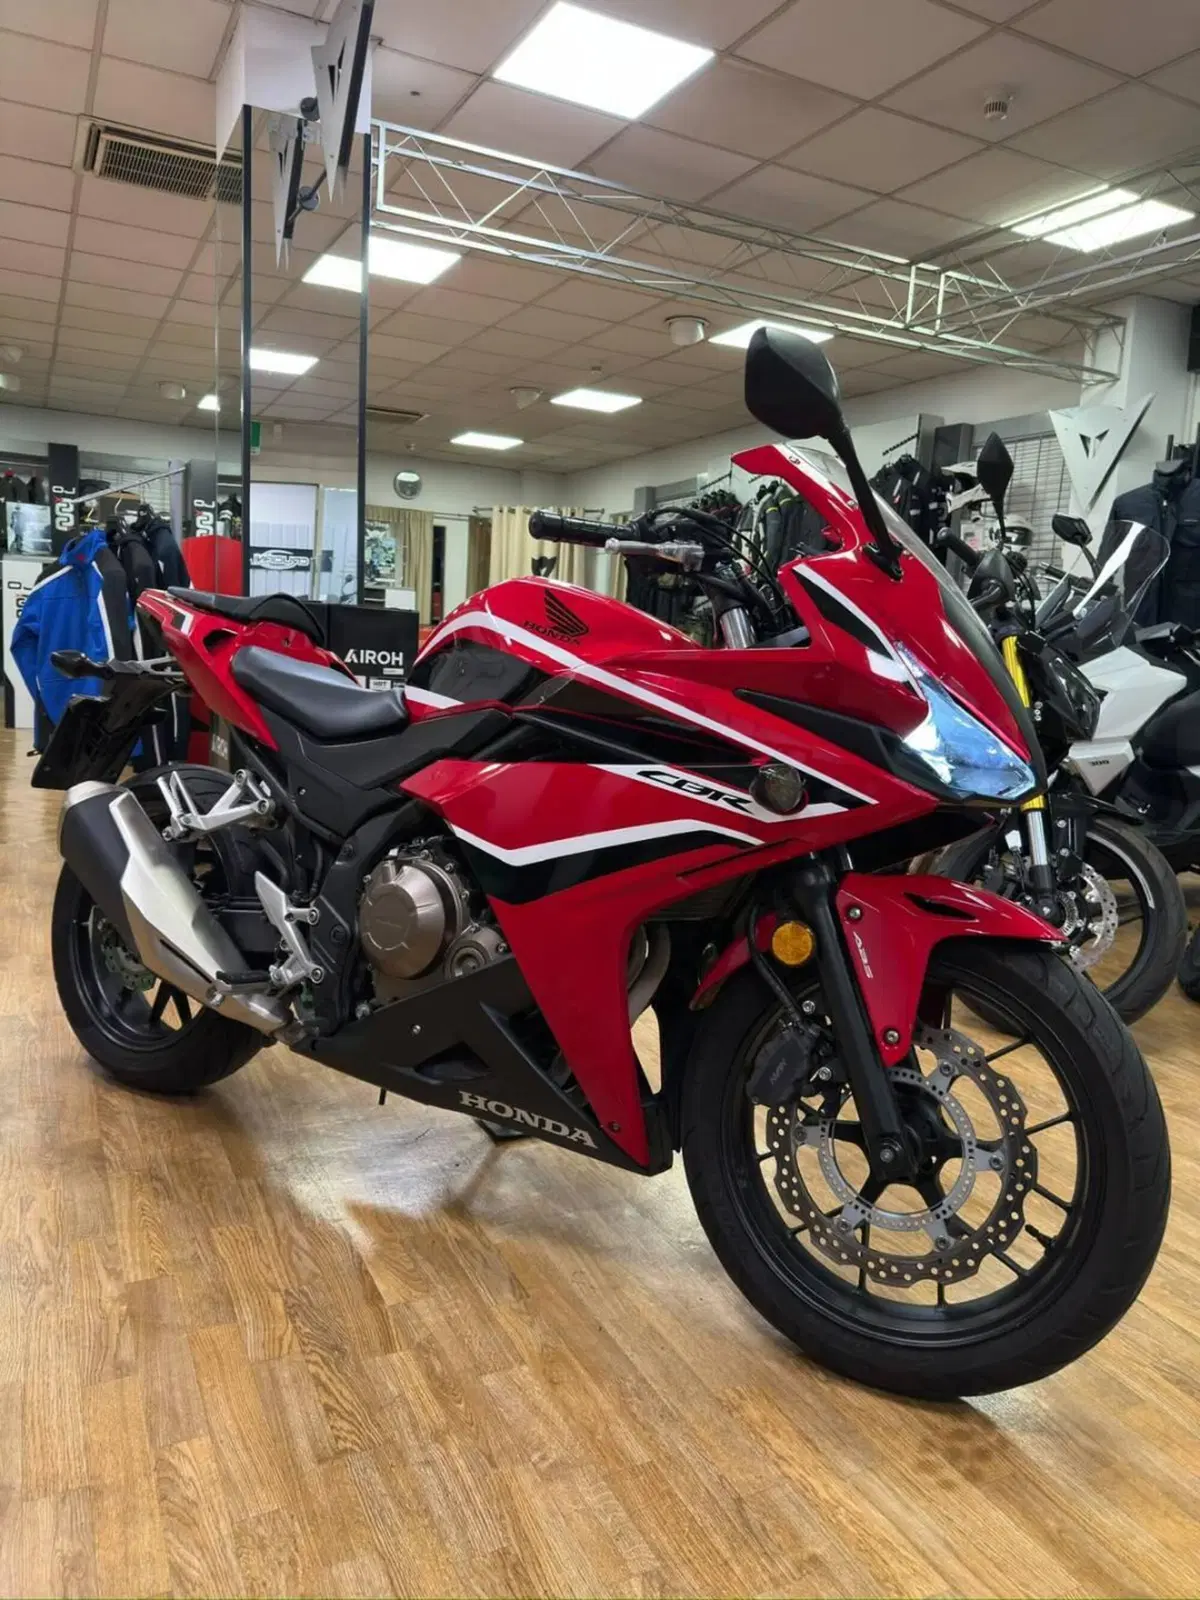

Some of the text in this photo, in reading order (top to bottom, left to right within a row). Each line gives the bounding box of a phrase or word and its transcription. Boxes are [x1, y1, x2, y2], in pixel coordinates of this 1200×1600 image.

[524, 621, 580, 644] HONDA
[344, 648, 403, 666] AIROH
[636, 770, 755, 815] CBR
[852, 930, 874, 979] ABS
[458, 1090, 598, 1149] HONDA
